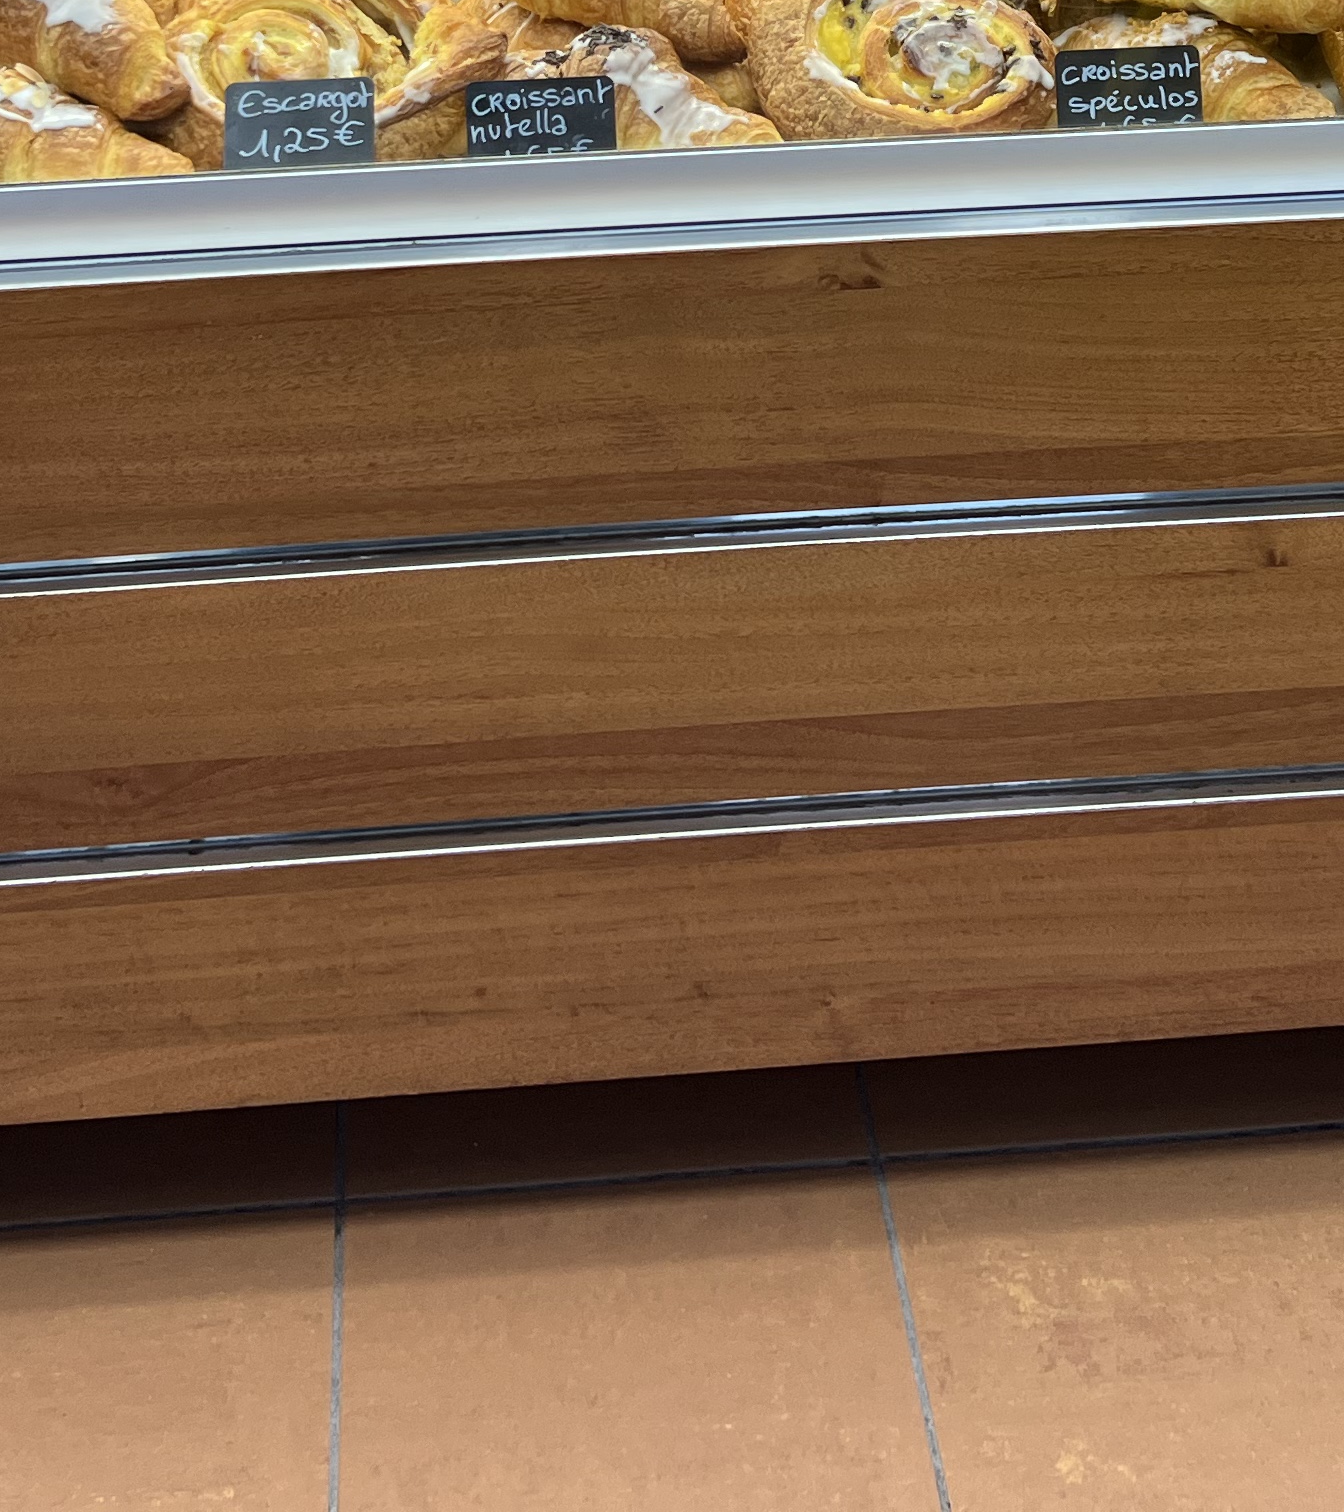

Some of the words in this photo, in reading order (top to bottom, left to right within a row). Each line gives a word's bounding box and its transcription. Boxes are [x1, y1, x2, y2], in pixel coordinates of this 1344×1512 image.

[238, 81, 373, 124] Escargot
[1068, 85, 1199, 120] spéculos
[238, 121, 365, 163] 1,25€
[471, 108, 568, 145] nutella
